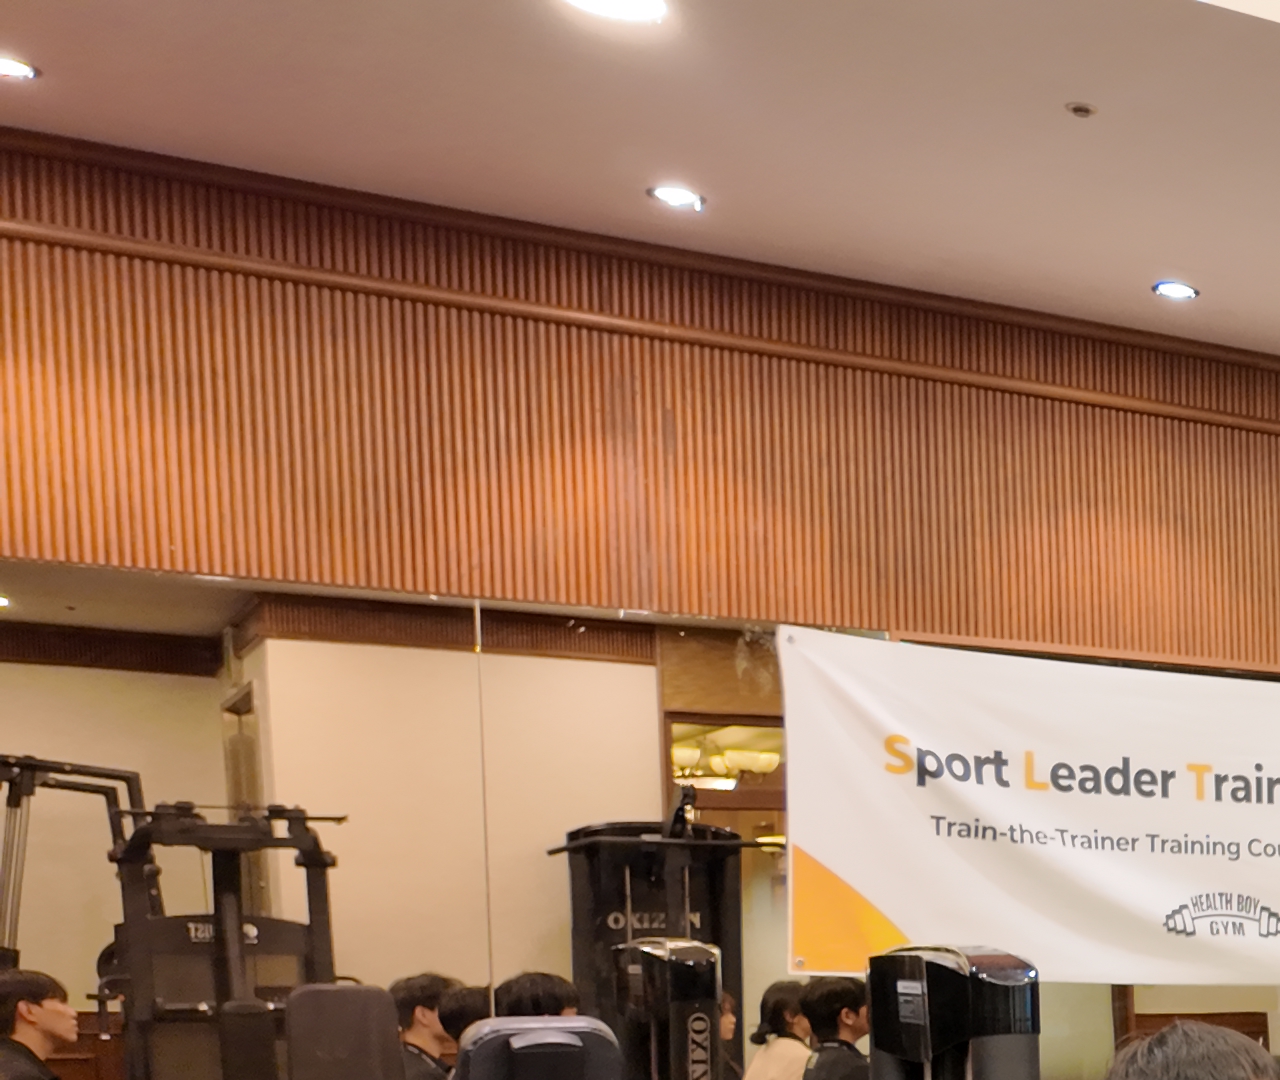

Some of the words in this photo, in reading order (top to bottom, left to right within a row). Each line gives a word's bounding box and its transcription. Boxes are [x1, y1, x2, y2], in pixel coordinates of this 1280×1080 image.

[884, 734, 1010, 787] Sport
[1024, 750, 1176, 798] Leader
[930, 815, 1139, 852] Train-the-Trainer
[1145, 833, 1241, 861] Training
[1191, 892, 1233, 913] HEALTH
[1237, 893, 1260, 915] BOY
[607, 912, 701, 930] OXIZN
[1210, 920, 1245, 936] GYM
